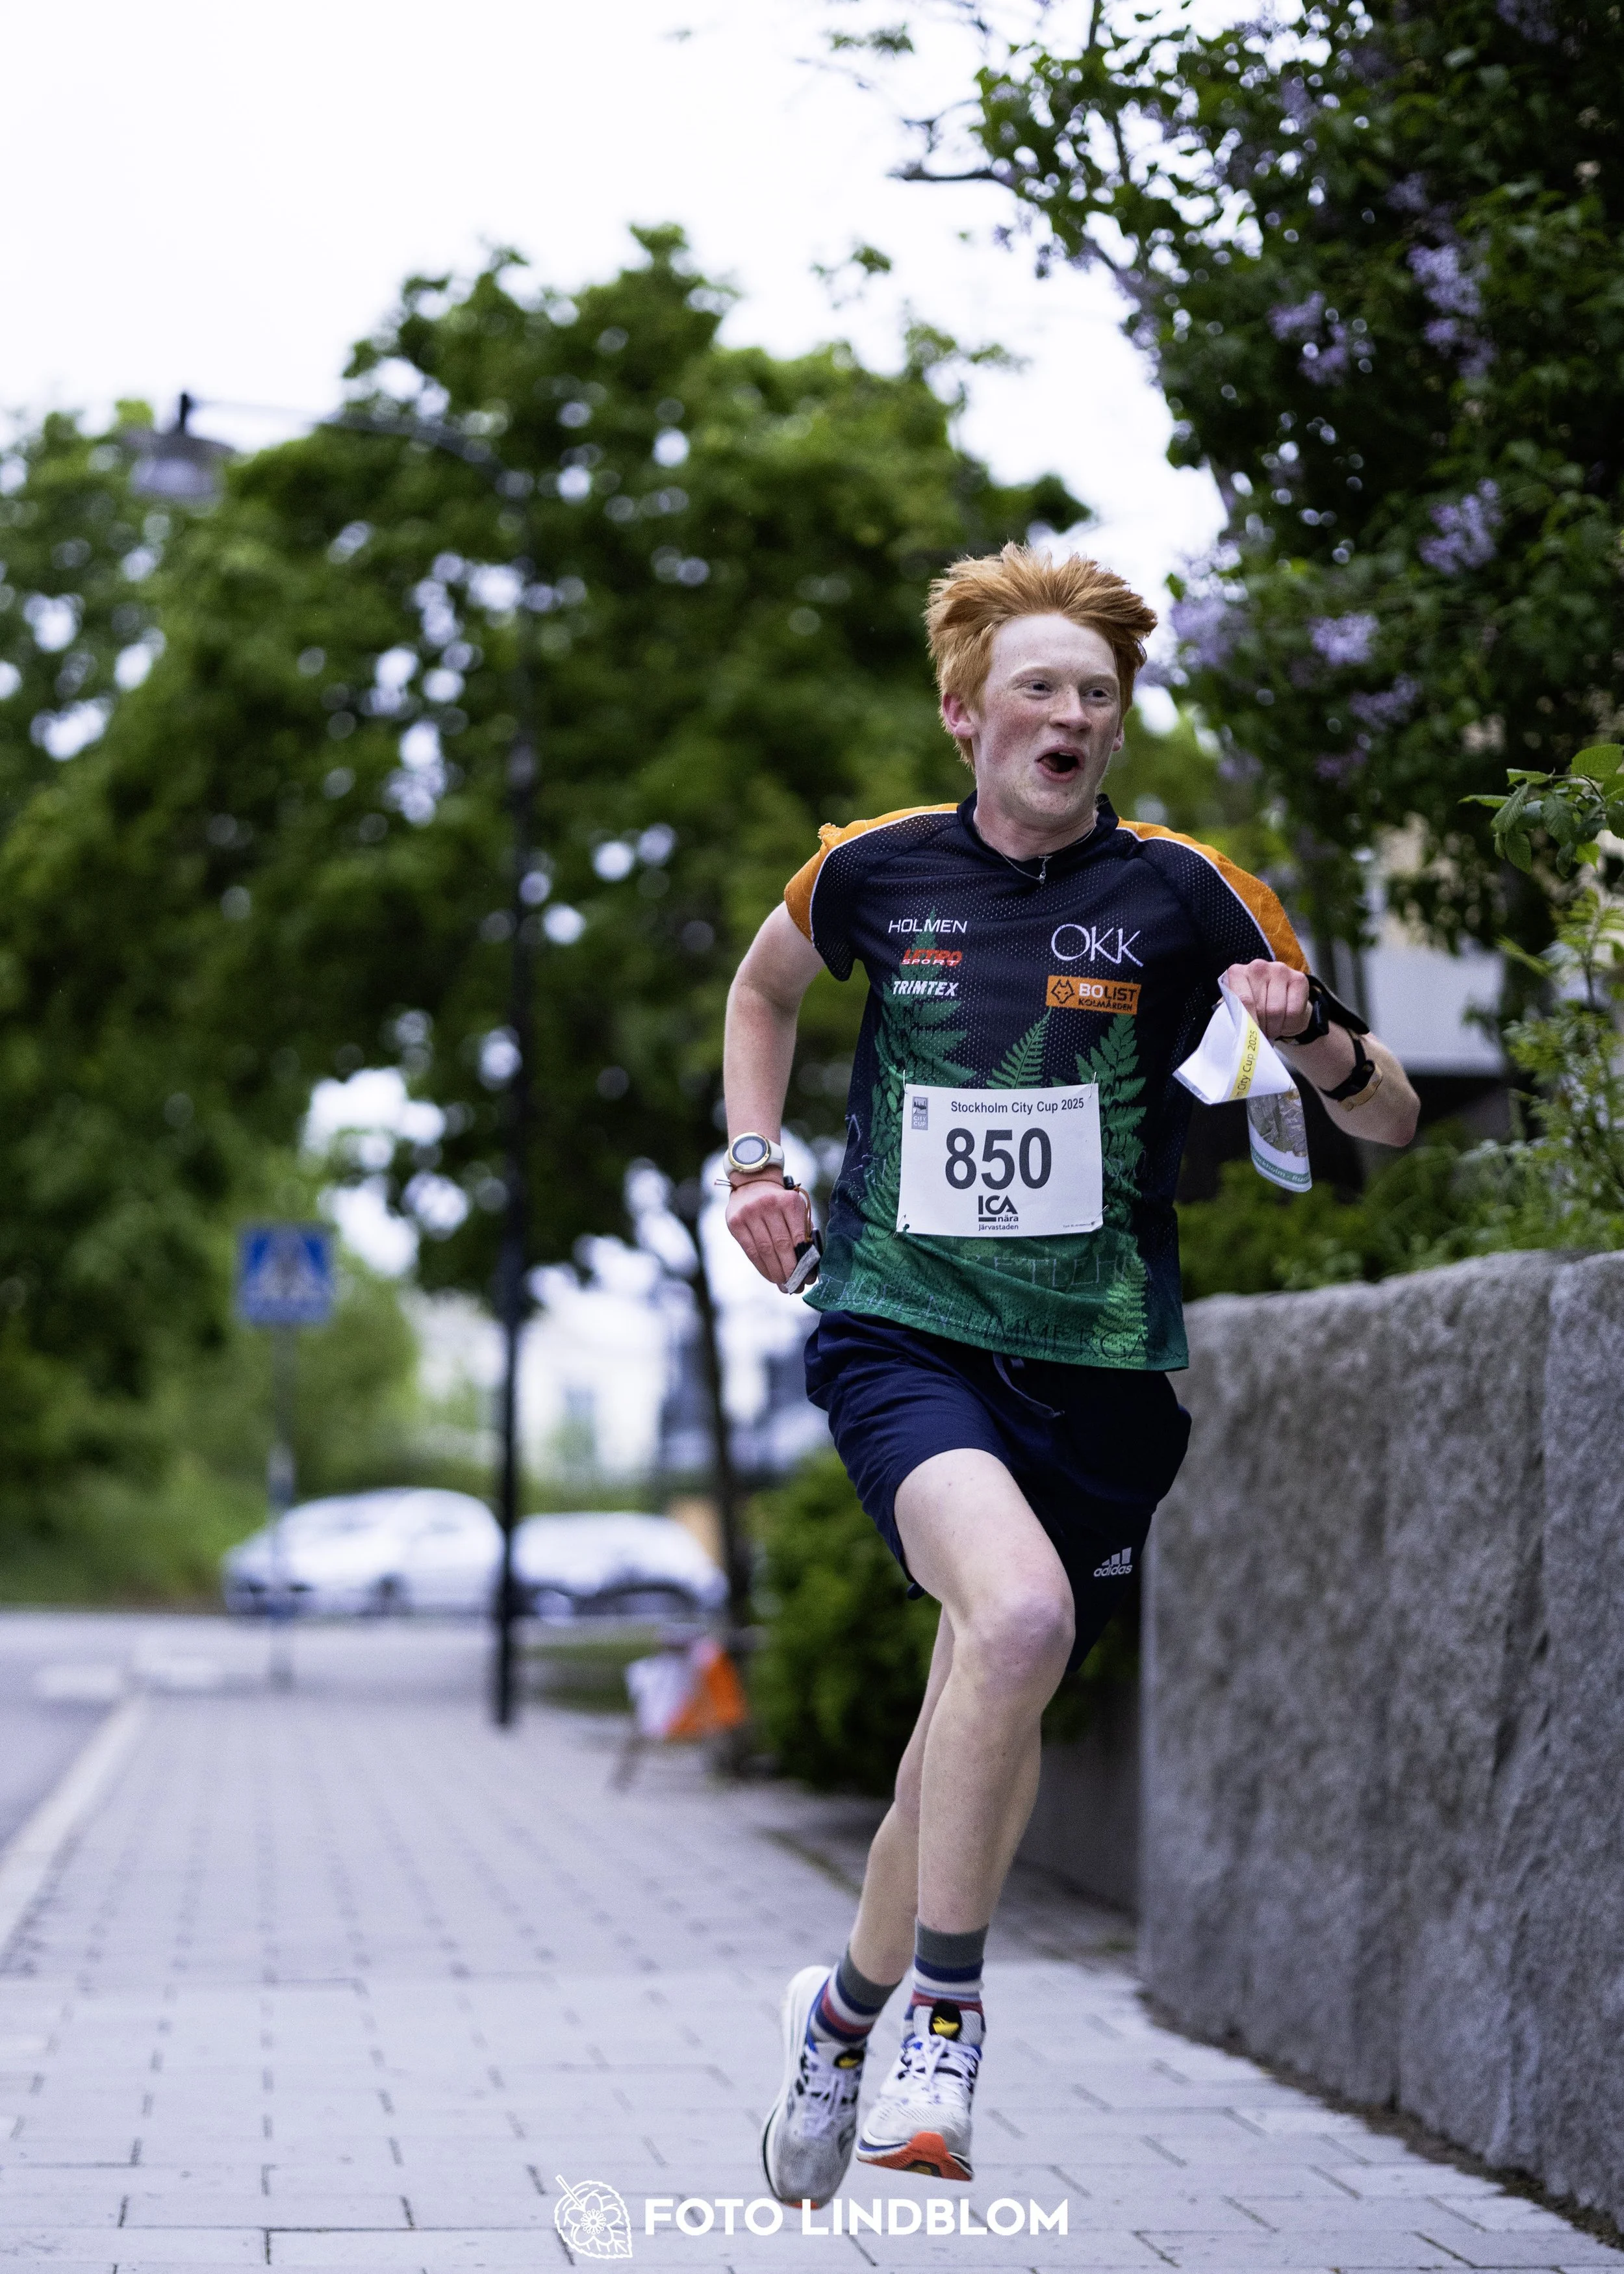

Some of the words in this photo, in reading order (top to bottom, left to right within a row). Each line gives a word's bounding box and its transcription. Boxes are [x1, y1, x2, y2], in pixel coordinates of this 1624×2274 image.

[888, 919, 968, 933] HOLMEN
[1051, 923, 1144, 967] OKK
[893, 980, 959, 997] TRIMTEX
[1078, 983, 1137, 1002] BOLIST
[1078, 998, 1133, 1012] KOLMÅRDEN
[1247, 1030, 1258, 1052] 2025
[1243, 1053, 1256, 1073] Cup
[1237, 1075, 1251, 1091] City
[950, 1101, 1008, 1114] Stockholm
[1011, 1101, 1034, 1115] City
[1036, 1101, 1058, 1114] Cup
[1061, 1097, 1084, 1110] 2025
[945, 1127, 1052, 1190] 850
[978, 1195, 1019, 1216] ICA
[1093, 1564, 1133, 1577] adidas
